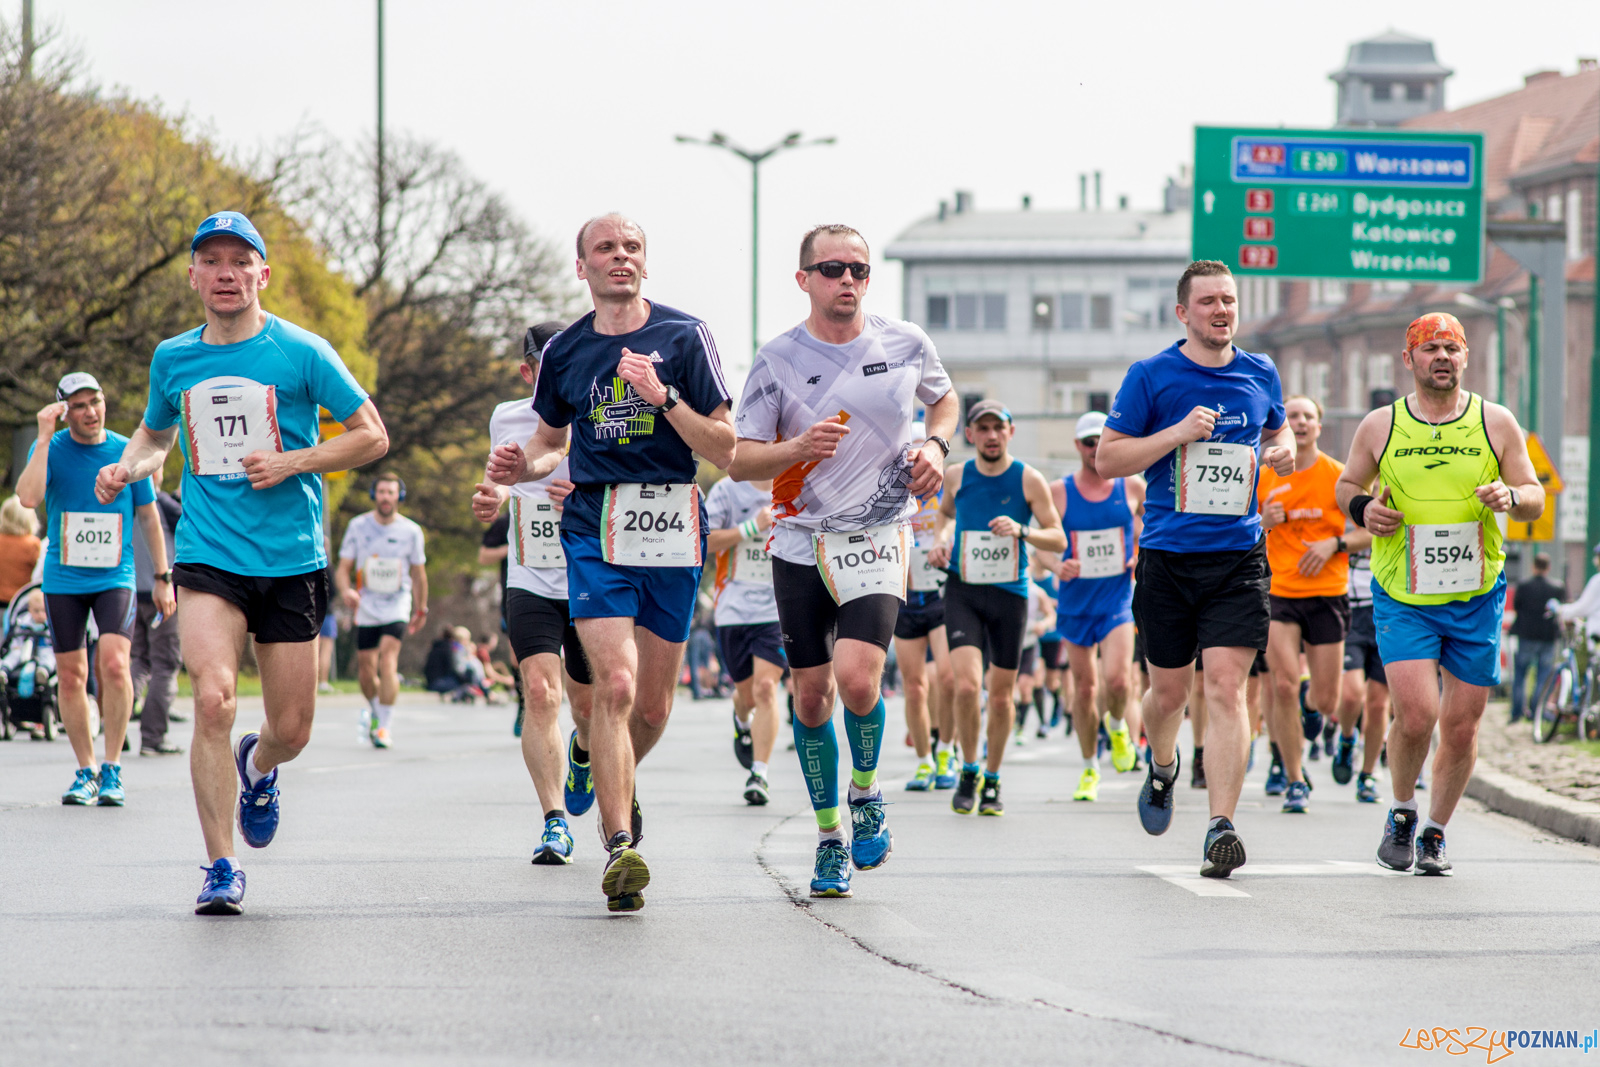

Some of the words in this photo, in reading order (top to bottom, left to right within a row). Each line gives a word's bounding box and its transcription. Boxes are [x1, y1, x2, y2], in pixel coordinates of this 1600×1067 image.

[1301, 151, 1311, 171] E
[1315, 151, 1338, 171] 30
[1355, 152, 1466, 176] Warszawa
[1297, 191, 1307, 212] E
[1353, 192, 1466, 220] Bydgoszcz
[1352, 221, 1457, 244] Katowice
[214, 415, 248, 437] 171
[1394, 446, 1482, 457] BROOKS
[1196, 465, 1244, 484] 7394
[624, 510, 684, 532] 2064
[76, 530, 111, 544] 6012
[746, 549, 772, 561] 183
[833, 545, 899, 570] 10041
[972, 547, 1009, 560] 9069
[1087, 544, 1114, 557] 8112
[1424, 545, 1474, 564] 5594
[857, 567, 885, 575] Mateusz
